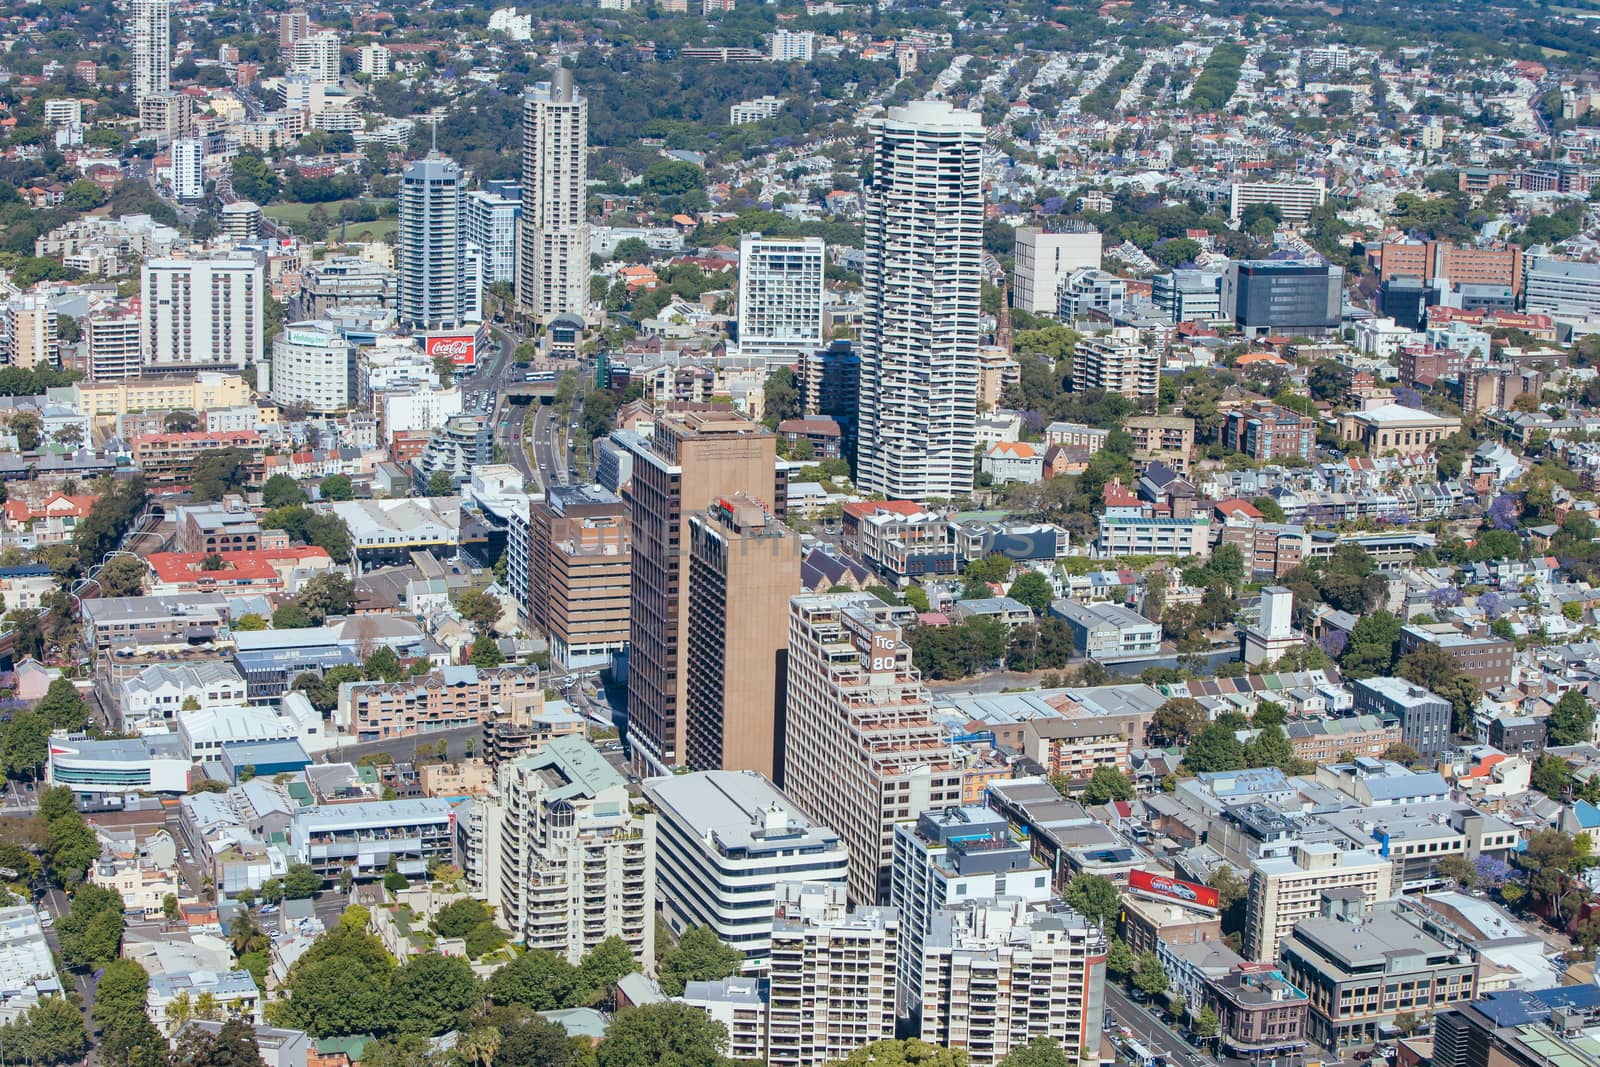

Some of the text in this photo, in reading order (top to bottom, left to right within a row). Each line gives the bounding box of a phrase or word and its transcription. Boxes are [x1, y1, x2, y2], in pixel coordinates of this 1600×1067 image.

[432, 341, 468, 356] Coca-Cola
[874, 635, 895, 650] TTG
[873, 656, 895, 671] 80
